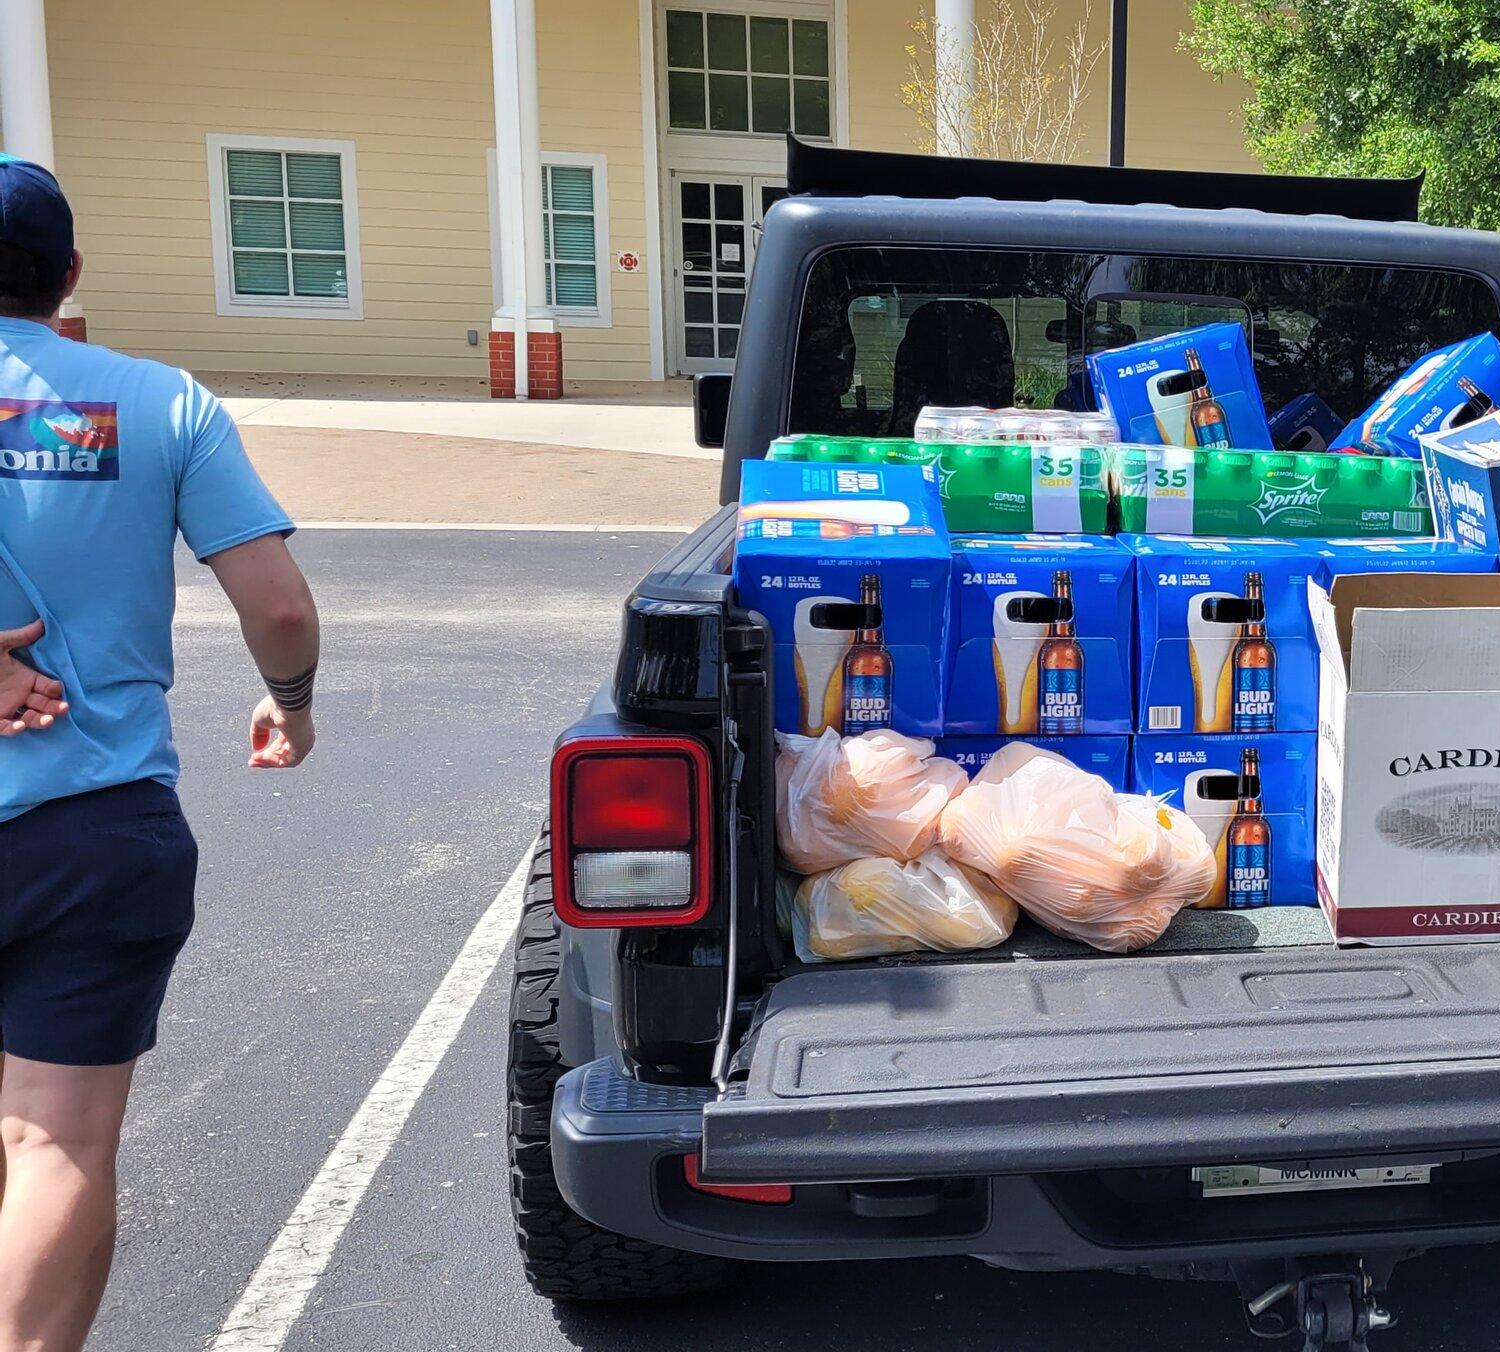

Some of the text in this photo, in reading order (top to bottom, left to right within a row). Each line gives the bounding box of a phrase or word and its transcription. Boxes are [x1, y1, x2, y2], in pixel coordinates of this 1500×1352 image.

[1118, 366, 1134, 378] 24
[1408, 424, 1424, 440] 24
[0, 445, 100, 472] onia
[1039, 455, 1073, 476] 35
[1040, 478, 1072, 487] cans
[1154, 468, 1187, 487] 35
[1154, 489, 1186, 497] cans
[1258, 490, 1318, 510] Sprite
[761, 576, 783, 588] 24
[962, 573, 983, 585] 24
[1158, 574, 1177, 586] 24
[1045, 692, 1078, 705] BUD
[1239, 691, 1270, 703] BUD
[850, 698, 885, 710] BUD
[1235, 702, 1275, 715] LIGHT
[845, 708, 890, 722] LIGHT
[1041, 704, 1082, 717] LIGHT
[956, 753, 976, 765] 24
[1155, 752, 1174, 764] 24
[1234, 868, 1266, 880] BUD
[1230, 879, 1269, 891] LIGHT
